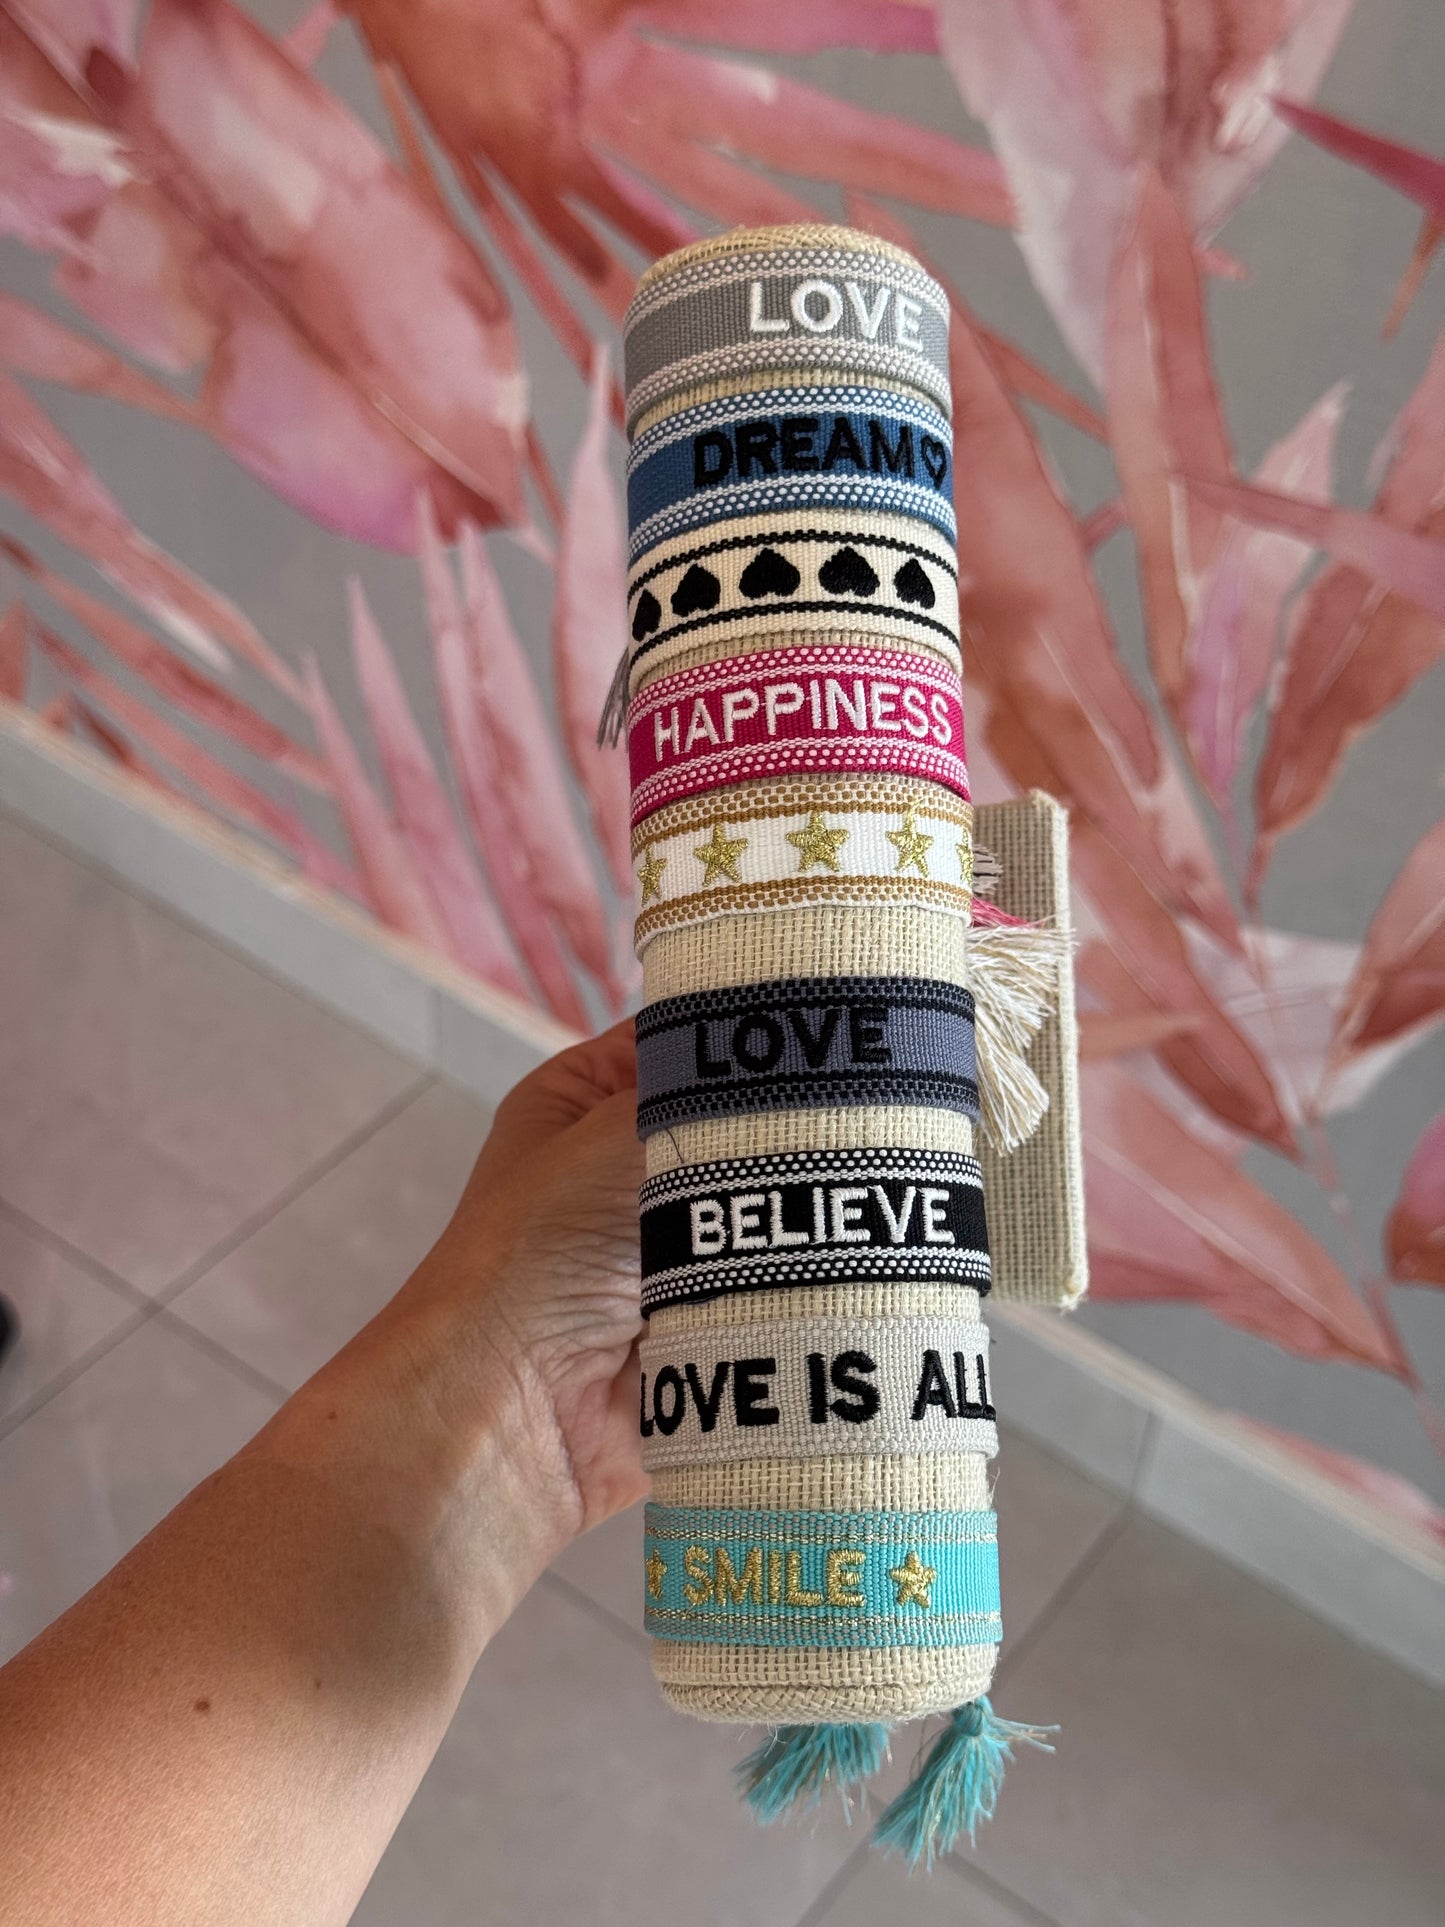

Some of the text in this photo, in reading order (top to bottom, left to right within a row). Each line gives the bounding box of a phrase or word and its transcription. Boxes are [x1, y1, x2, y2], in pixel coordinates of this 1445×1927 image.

[750, 279, 923, 354] LOVE
[693, 417, 914, 489] DREAM
[653, 679, 952, 762] HAPPINESS
[696, 1005, 892, 1079] LOVE
[690, 1185, 955, 1256] BELIEVE
[640, 1349, 996, 1437] LOVE IS ALL
[683, 1545, 865, 1608] SMILE
